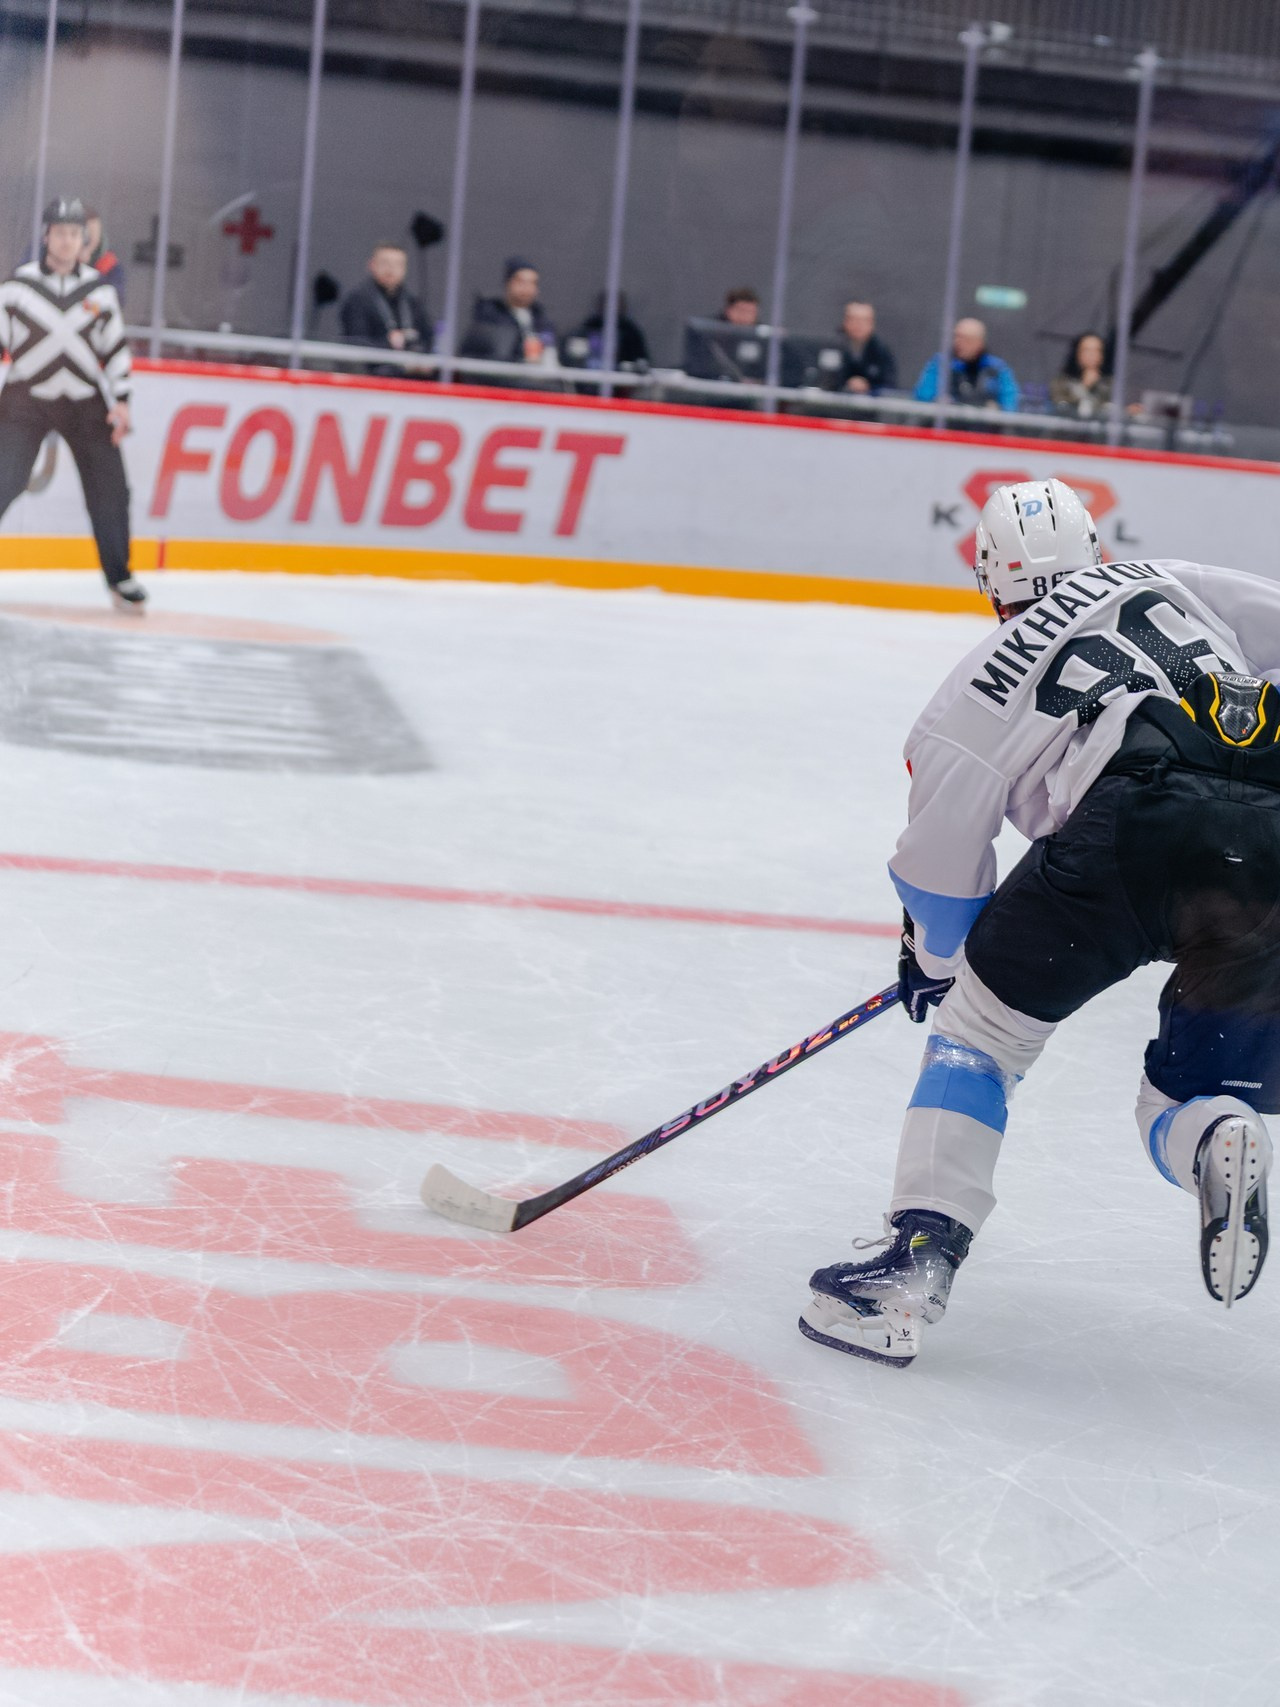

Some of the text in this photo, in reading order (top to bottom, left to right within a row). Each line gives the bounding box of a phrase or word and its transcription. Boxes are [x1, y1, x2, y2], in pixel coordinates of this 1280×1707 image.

[148, 403, 628, 538] FONBET
[1221, 1080, 1263, 1089] WARRIOR
[840, 1268, 887, 1283] BAUER
